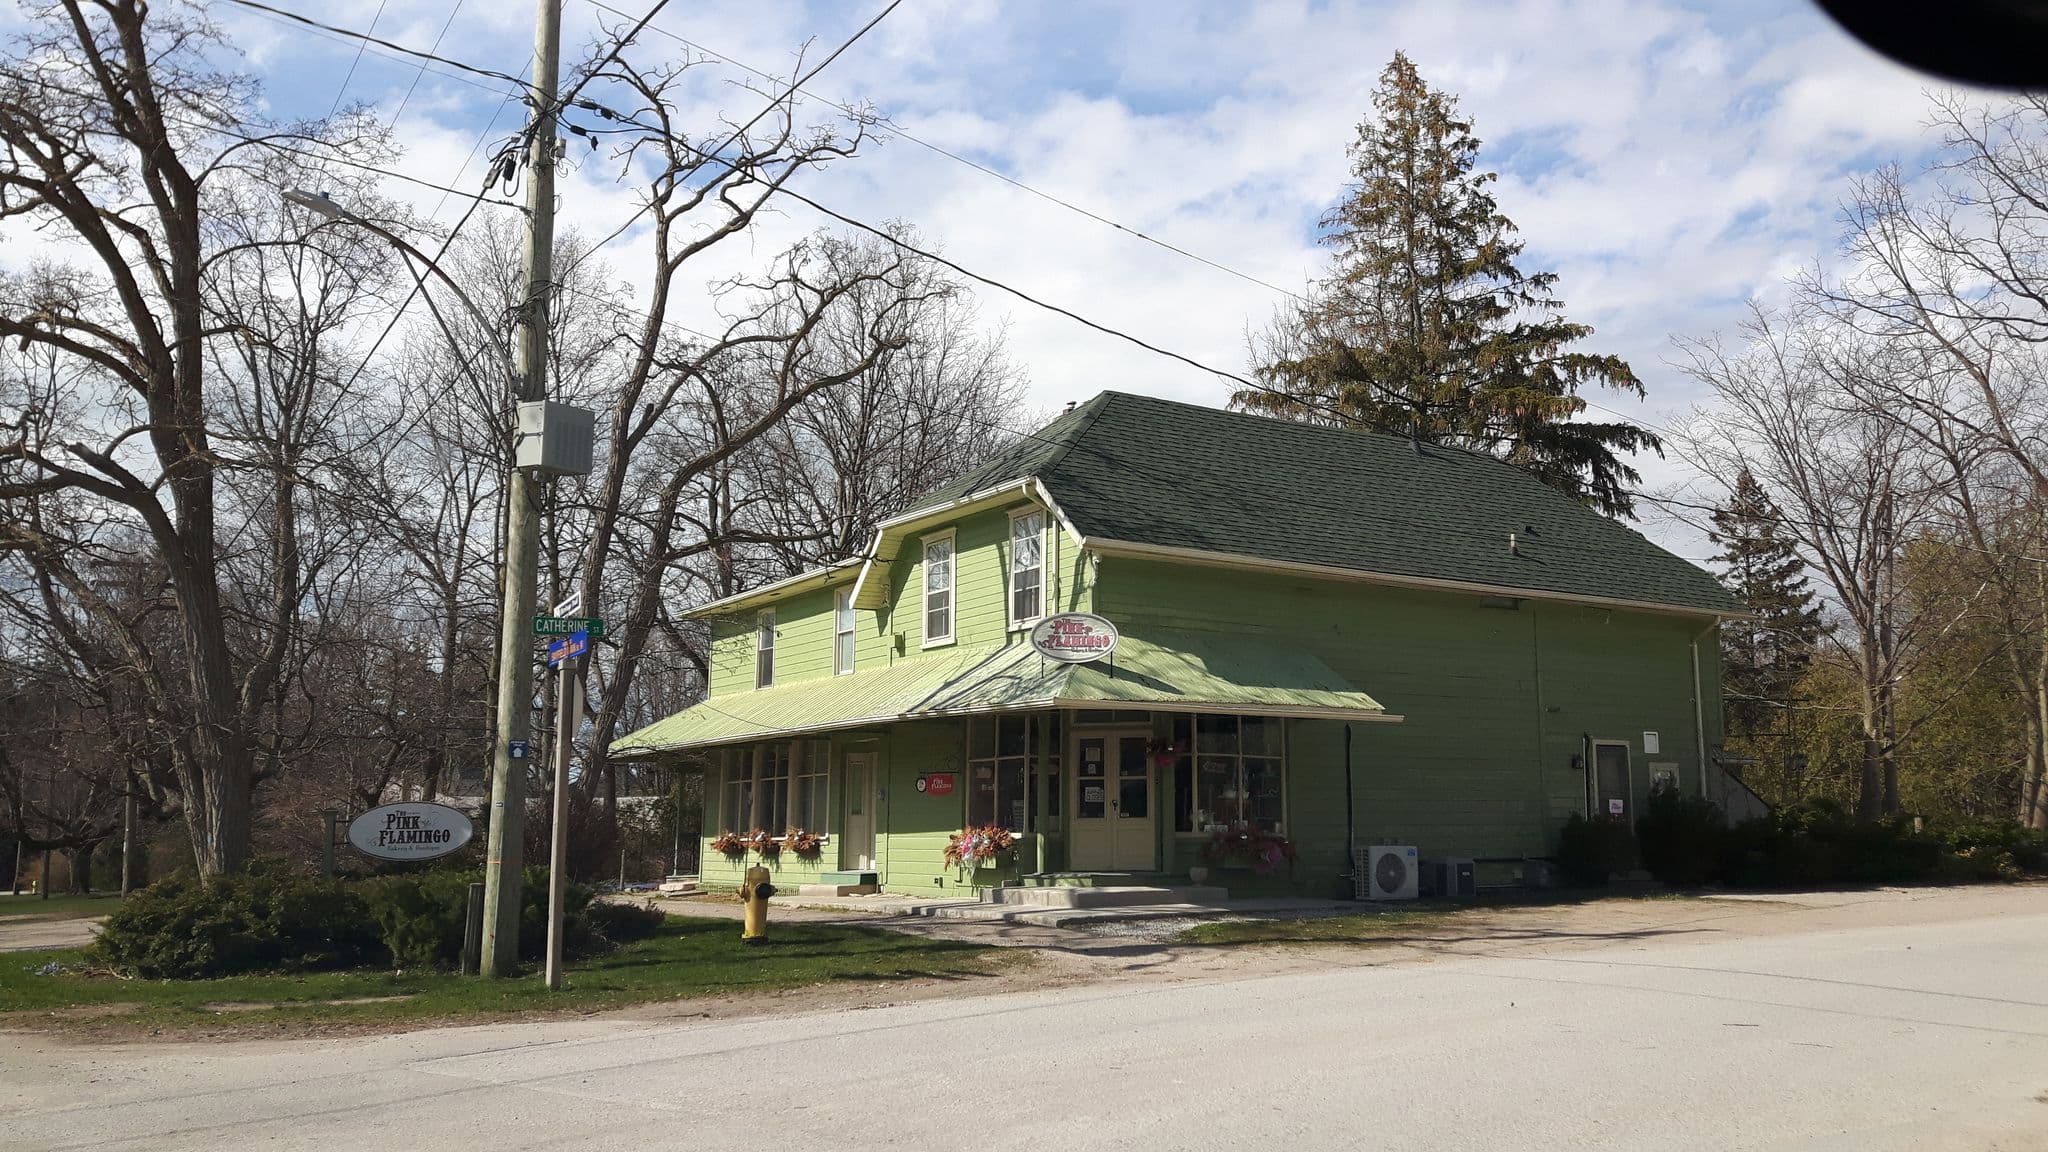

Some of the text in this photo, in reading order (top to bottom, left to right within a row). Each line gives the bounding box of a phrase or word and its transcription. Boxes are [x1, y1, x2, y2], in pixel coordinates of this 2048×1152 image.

[536, 619, 590, 633] CATHERINE
[1053, 620, 1085, 634] PINK
[1047, 634, 1110, 648] FLAMINGO
[386, 814, 421, 830] PINK
[378, 829, 451, 847] FLAMINGO
